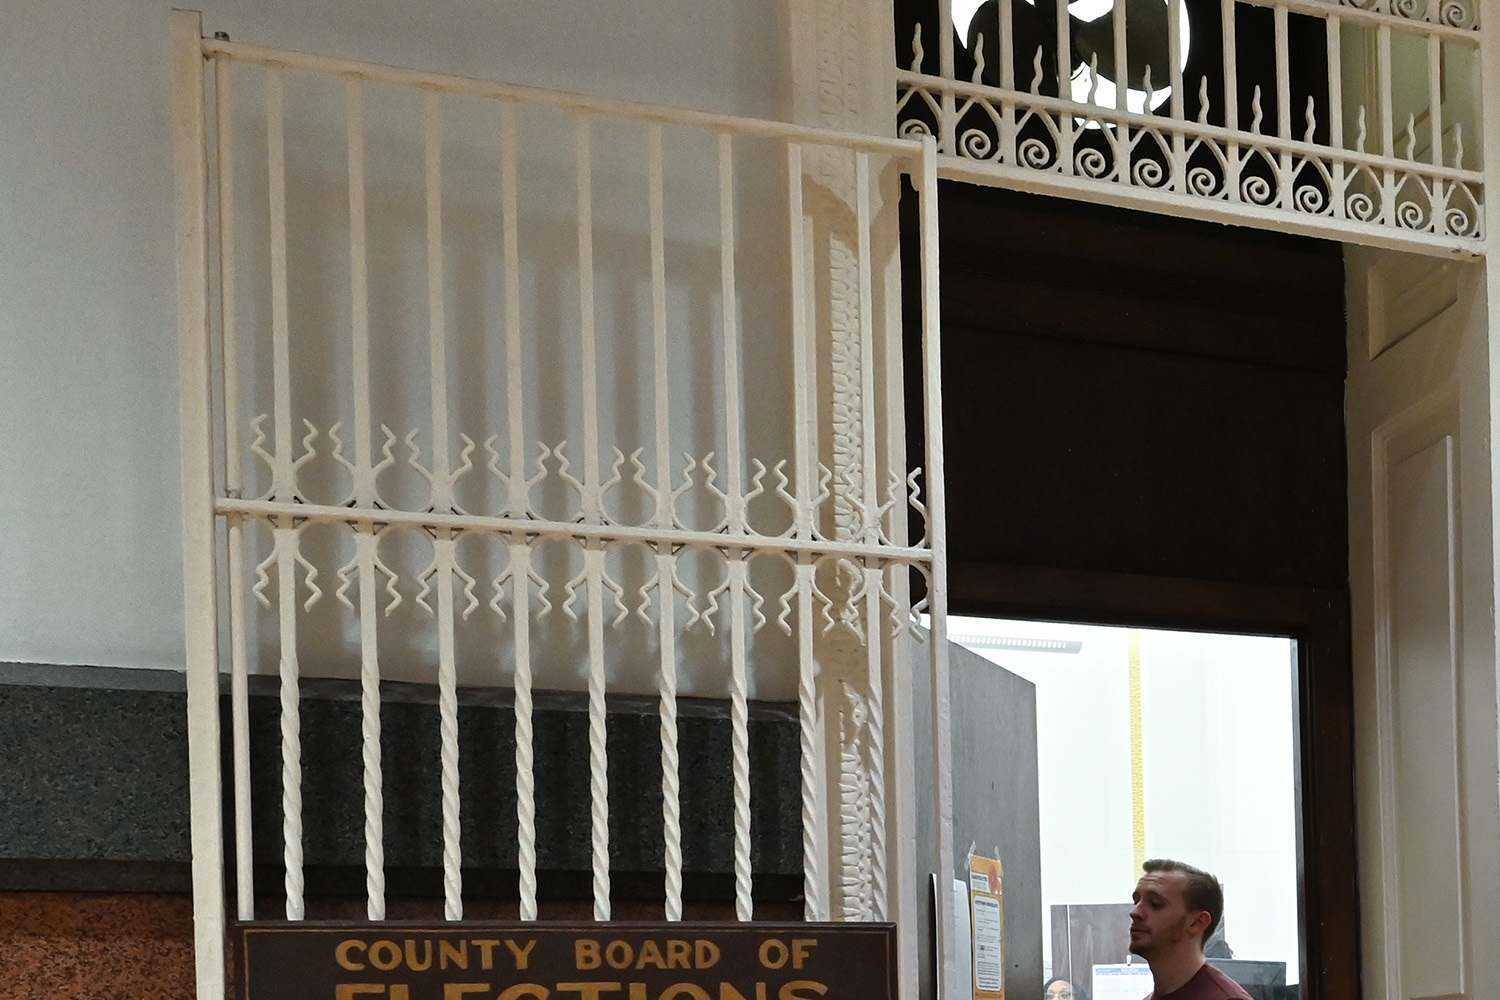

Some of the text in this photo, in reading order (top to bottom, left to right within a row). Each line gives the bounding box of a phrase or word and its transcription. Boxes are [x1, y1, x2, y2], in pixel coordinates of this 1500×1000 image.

[335, 938, 818, 971] COUNTY BOARD OF
